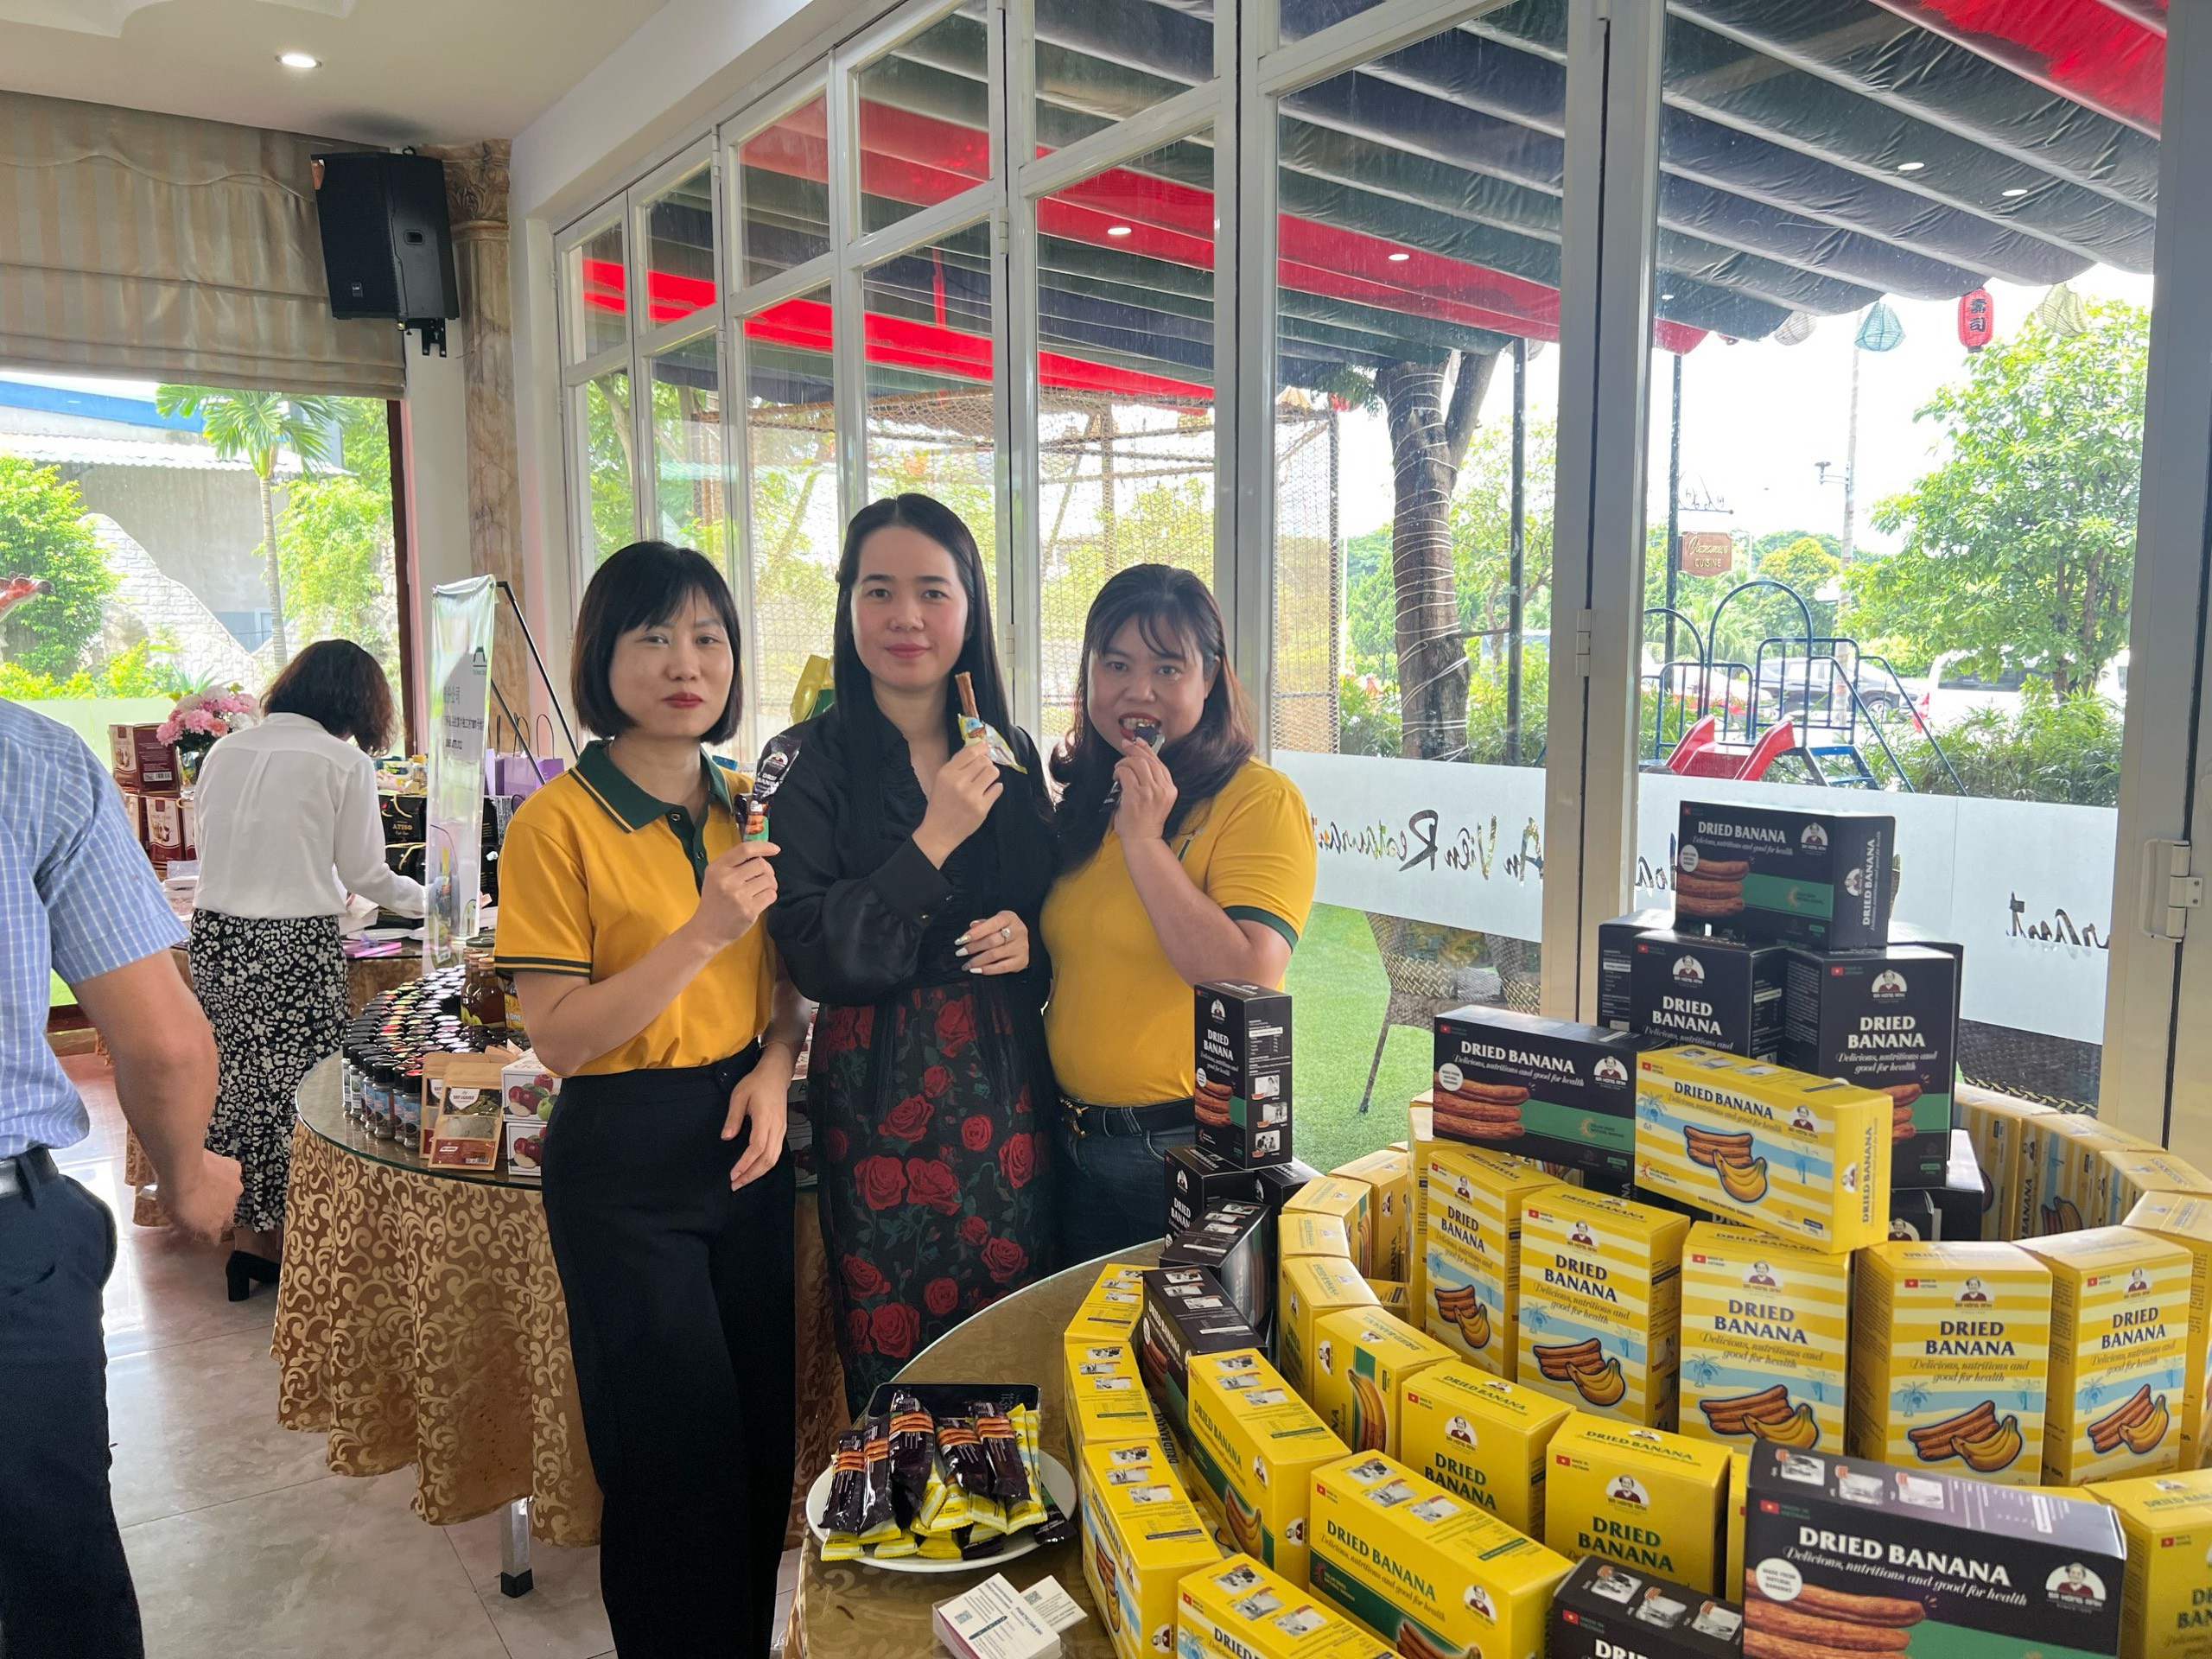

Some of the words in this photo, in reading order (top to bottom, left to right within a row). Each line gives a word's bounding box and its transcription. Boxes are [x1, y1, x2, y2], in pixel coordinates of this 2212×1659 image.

[1694, 558, 1721, 568] CUISINE
[1698, 822, 1732, 836] DRIED
[1735, 826, 1786, 843] BANANA
[1865, 839, 1875, 889] BANANA
[1863, 891, 1872, 925] DRIED
[1663, 995, 1713, 1016] DRIED
[1652, 1011, 1722, 1036] BANANA
[1860, 1016, 1916, 1031] DRIED
[1207, 1028, 1230, 1046] DRIED
[1847, 1033, 1926, 1049] BANANA
[1203, 1039, 1234, 1061] BANANA
[1461, 1040, 1506, 1060] DRIED
[1509, 1050, 1576, 1075] BANANA
[1920, 1051, 1937, 1060] and
[1854, 1063, 1876, 1074] good
[1890, 1062, 1916, 1071] health
[1562, 1076, 1585, 1087] health
[1674, 1082, 1713, 1102] DRIED
[1716, 1091, 1774, 1121] BANANA
[1171, 1207, 1191, 1228] BANAN
[1173, 1198, 1191, 1218] DRIED
[1448, 1205, 1478, 1231] DRIED
[1560, 1194, 1595, 1206] DRIED
[1597, 1204, 1644, 1220] BANANA
[1441, 1218, 1485, 1253] BANANA
[1555, 1255, 1607, 1281] DRIED
[1545, 1268, 1618, 1303] BANANA
[1551, 1301, 1570, 1313] good
[1571, 1305, 1583, 1316] for
[1583, 1311, 1609, 1324] health
[1613, 1311, 1630, 1319] and
[1729, 1299, 1795, 1322] DRIED
[2112, 1307, 2158, 1329] DRIED
[1714, 1315, 1808, 1344] BANANA
[1940, 1320, 2005, 1336] DRIED
[2101, 1324, 2167, 1350] BANANA
[1802, 1352, 1824, 1361] and
[1925, 1340, 2016, 1356] BANANA
[2162, 1340, 2176, 1351] and
[1722, 1350, 1748, 1361] good
[1749, 1352, 1764, 1363] for
[1764, 1356, 1797, 1369] health
[2011, 1360, 2030, 1370] and
[2107, 1363, 2124, 1377] good
[2136, 1357, 2158, 1369] health
[1932, 1373, 1957, 1383] good
[1958, 1372, 1973, 1383] for
[1974, 1373, 2005, 1382] health
[1443, 1376, 1478, 1391] DRIED
[1478, 1389, 1527, 1411] BANANA
[1194, 1400, 1214, 1432] DRIED
[1214, 1427, 1242, 1471] BANANA
[1586, 1430, 1629, 1444] DRIED
[1631, 1440, 1693, 1460] BANANA
[1435, 1452, 1486, 1486] DRIED
[1425, 1466, 1497, 1510] BANANA
[1592, 1516, 1661, 1547] DRIED
[1327, 1520, 1369, 1556] DRIED
[1372, 1548, 1436, 1601] BANANA
[1578, 1532, 1675, 1573] BANANA
[1799, 1526, 1883, 1560] DRIED
[1889, 1543, 2012, 1587] BANANA
[1907, 1573, 1934, 1588] and
[1933, 1577, 1966, 1595] good
[1966, 1581, 1986, 1599] for
[1986, 1587, 2027, 1606] health
[1424, 1601, 1446, 1623] health
